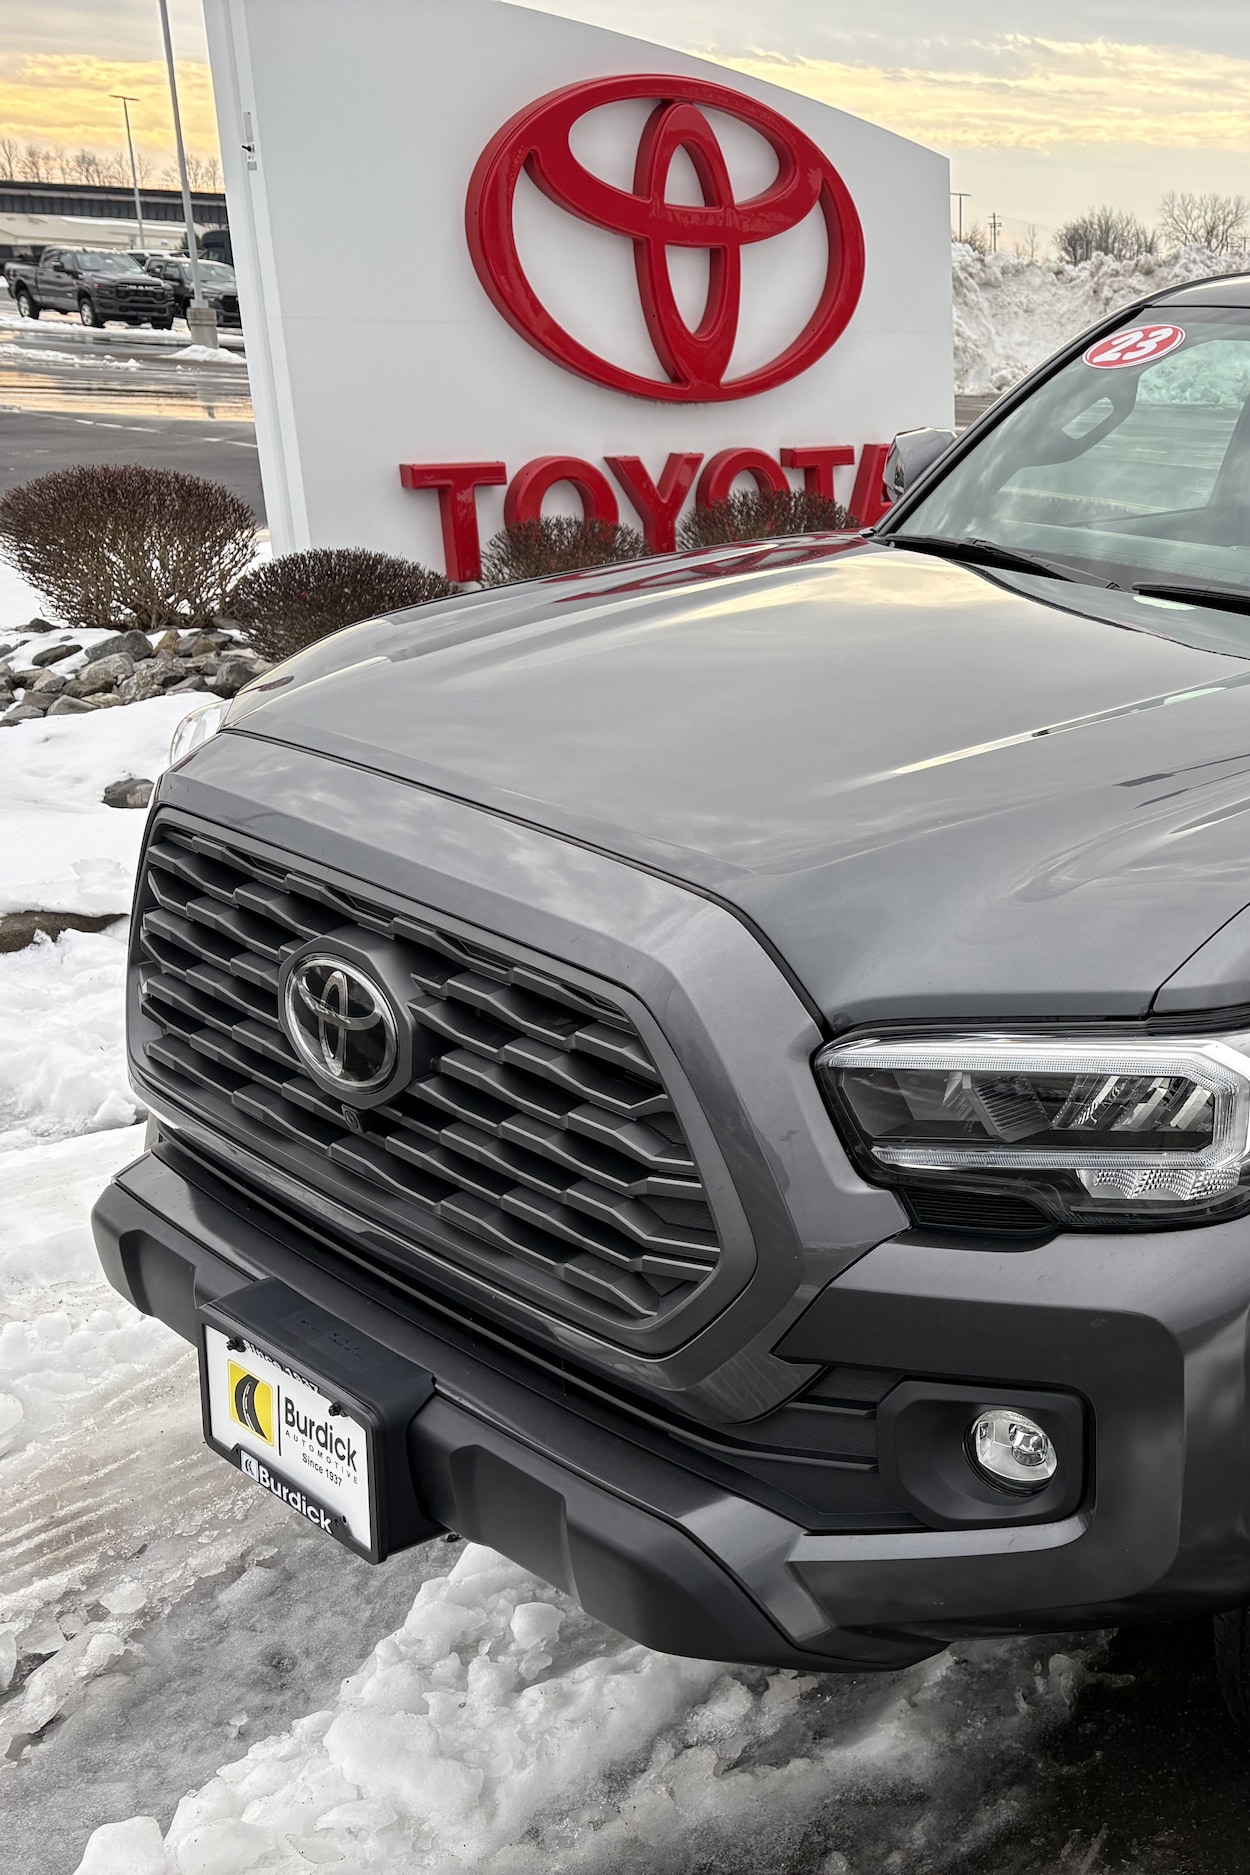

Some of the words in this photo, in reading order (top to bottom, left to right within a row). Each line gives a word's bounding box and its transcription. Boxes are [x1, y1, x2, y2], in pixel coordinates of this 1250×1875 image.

[1092, 327, 1174, 363] 23
[284, 1396, 358, 1473] Burdick
[285, 1429, 358, 1485] AUTOMOTIVE
[302, 1452, 324, 1474] Since
[325, 1468, 343, 1487] 1937
[258, 1464, 333, 1535] Burdick
